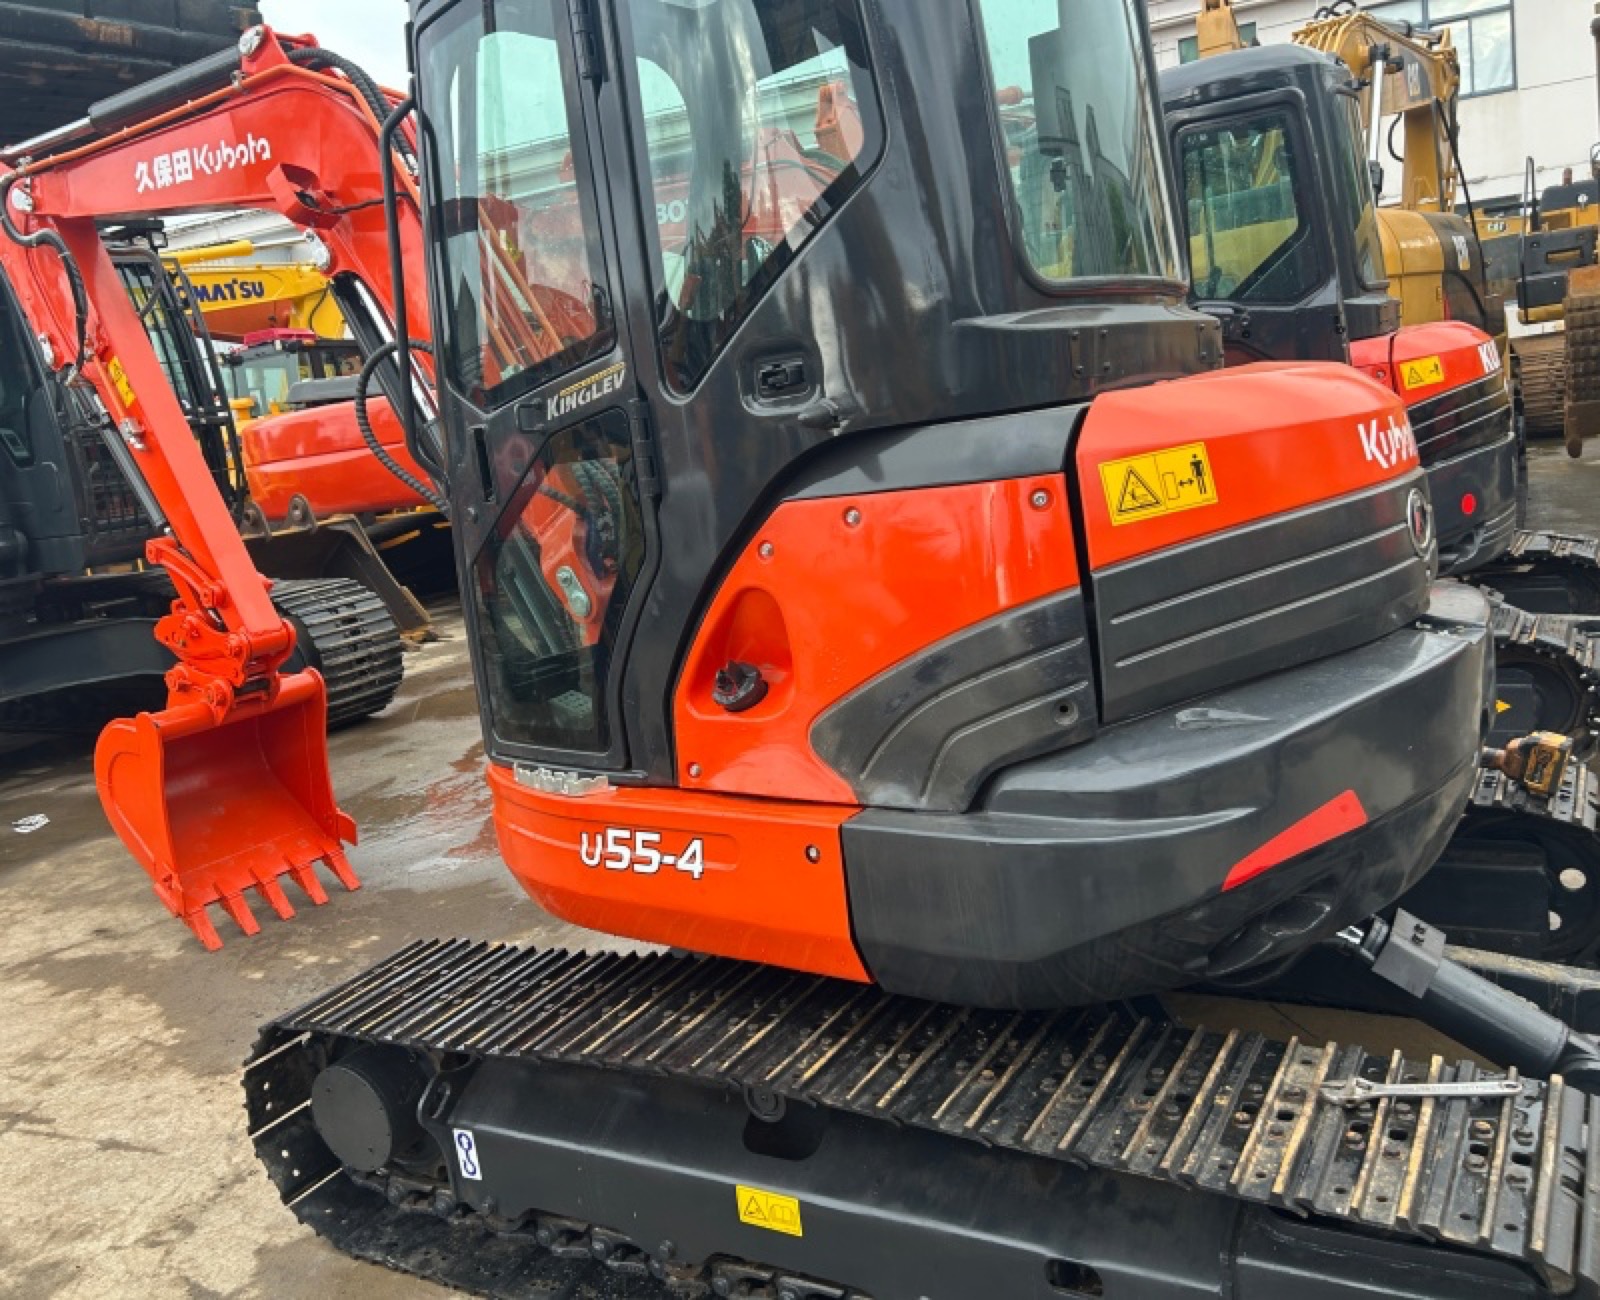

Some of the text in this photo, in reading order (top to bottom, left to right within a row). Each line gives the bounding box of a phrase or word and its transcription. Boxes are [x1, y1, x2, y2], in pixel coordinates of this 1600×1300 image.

[134, 132, 271, 194] 久保田 Kubota
[580, 827, 704, 881] U55-4
